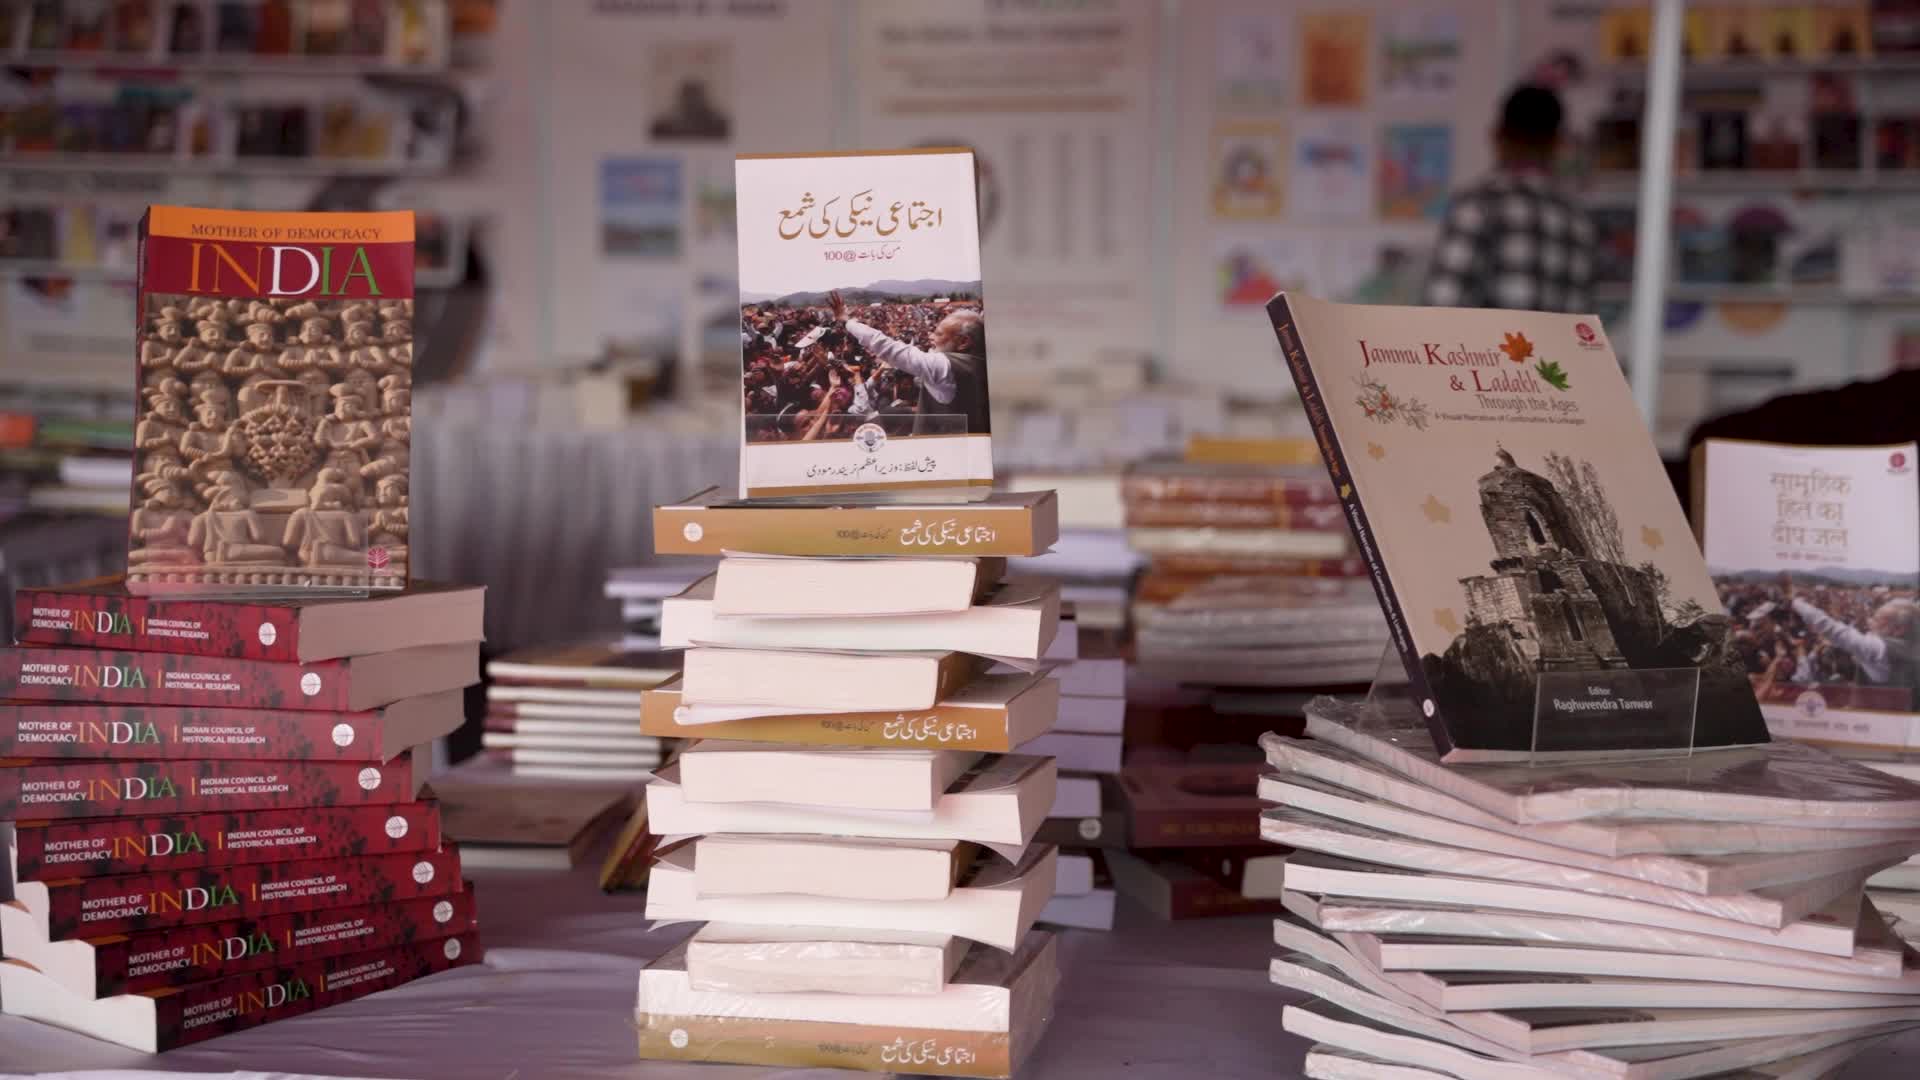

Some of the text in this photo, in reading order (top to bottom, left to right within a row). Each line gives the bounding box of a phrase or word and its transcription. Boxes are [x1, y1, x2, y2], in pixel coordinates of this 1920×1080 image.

[778, 188, 943, 240] اجتماعی نیکی کی شمع
[191, 223, 383, 241] MOTHER OF DEMOCRACY
[187, 243, 383, 296] INDIA
[1358, 340, 1501, 368] Jammu Kashmir
[1450, 370, 1543, 394] & Ladakh
[1474, 393, 1579, 415] Through the Ages
[900, 519, 923, 546] شمع
[917, 521, 936, 546] کی
[932, 518, 957, 546] نیکی
[956, 525, 996, 546] اجتماعی
[33, 607, 71, 618] MOTHER OF
[73, 609, 132, 635] INDIA
[32, 618, 74, 630] DEMOCRACY
[148, 619, 201, 629] INDIAN COUNCIL OF
[147, 628, 209, 640] HISTORICAL RESEARCH
[22, 664, 70, 674] MOTHER OF
[73, 664, 147, 689] INDIA
[166, 671, 232, 681] INDIAN COUNCIL OF
[21, 676, 73, 686] DEMOCRACY
[165, 681, 240, 691] HISTORICAL RESEARCH
[1587, 686, 1612, 696] Editor
[1553, 698, 1653, 713] Raghuvendra Tanwar
[18, 721, 73, 731] MOTHER OF
[77, 720, 161, 744] INDIA
[182, 726, 257, 735] INDIAN COUNCIL OF
[883, 713, 905, 740] شمع
[899, 717, 920, 740] کی
[914, 716, 938, 741] نیکی
[937, 722, 977, 742] اجتماعی
[18, 733, 77, 743] DEMOCRACY
[182, 735, 266, 744] HISTORICAL RESEARCH
[22, 780, 81, 791] MOTHER OF
[87, 775, 177, 801] INDIA
[200, 775, 278, 786] INDIAN COUNCIL OF
[200, 784, 289, 795] HISTORICAL RESEARCH
[22, 791, 87, 803] DEMOCRACY
[227, 827, 305, 840] INDIAN COUNCIL OF
[227, 835, 317, 849] HISTORICAL RESEARCH
[44, 837, 107, 852] MOTHER OF
[113, 831, 206, 859] INDIA
[45, 850, 112, 864] DEMOCRACY
[261, 875, 337, 891] INDIAN COUNCIL OF
[261, 883, 348, 901] HISTORICAL RESEARCH
[82, 893, 143, 910] MOTHER OF
[149, 884, 239, 914] INDIA
[82, 906, 149, 922] DEMOCRACY
[295, 919, 365, 937] INDIAN COUNCIL OF
[295, 926, 375, 947] HISTORICAL RESEARCH
[128, 946, 186, 965] MOTHER OF
[191, 932, 275, 966] INDIA
[129, 958, 192, 977] DEMOCRACY
[238, 977, 310, 1016] INDIA
[183, 996, 233, 1017] MOTHER OF
[184, 1007, 239, 1029] DEMOCRACY
[880, 1036, 903, 1063] شمع
[897, 1041, 918, 1064] کی
[936, 1046, 976, 1066] اجتماعی
